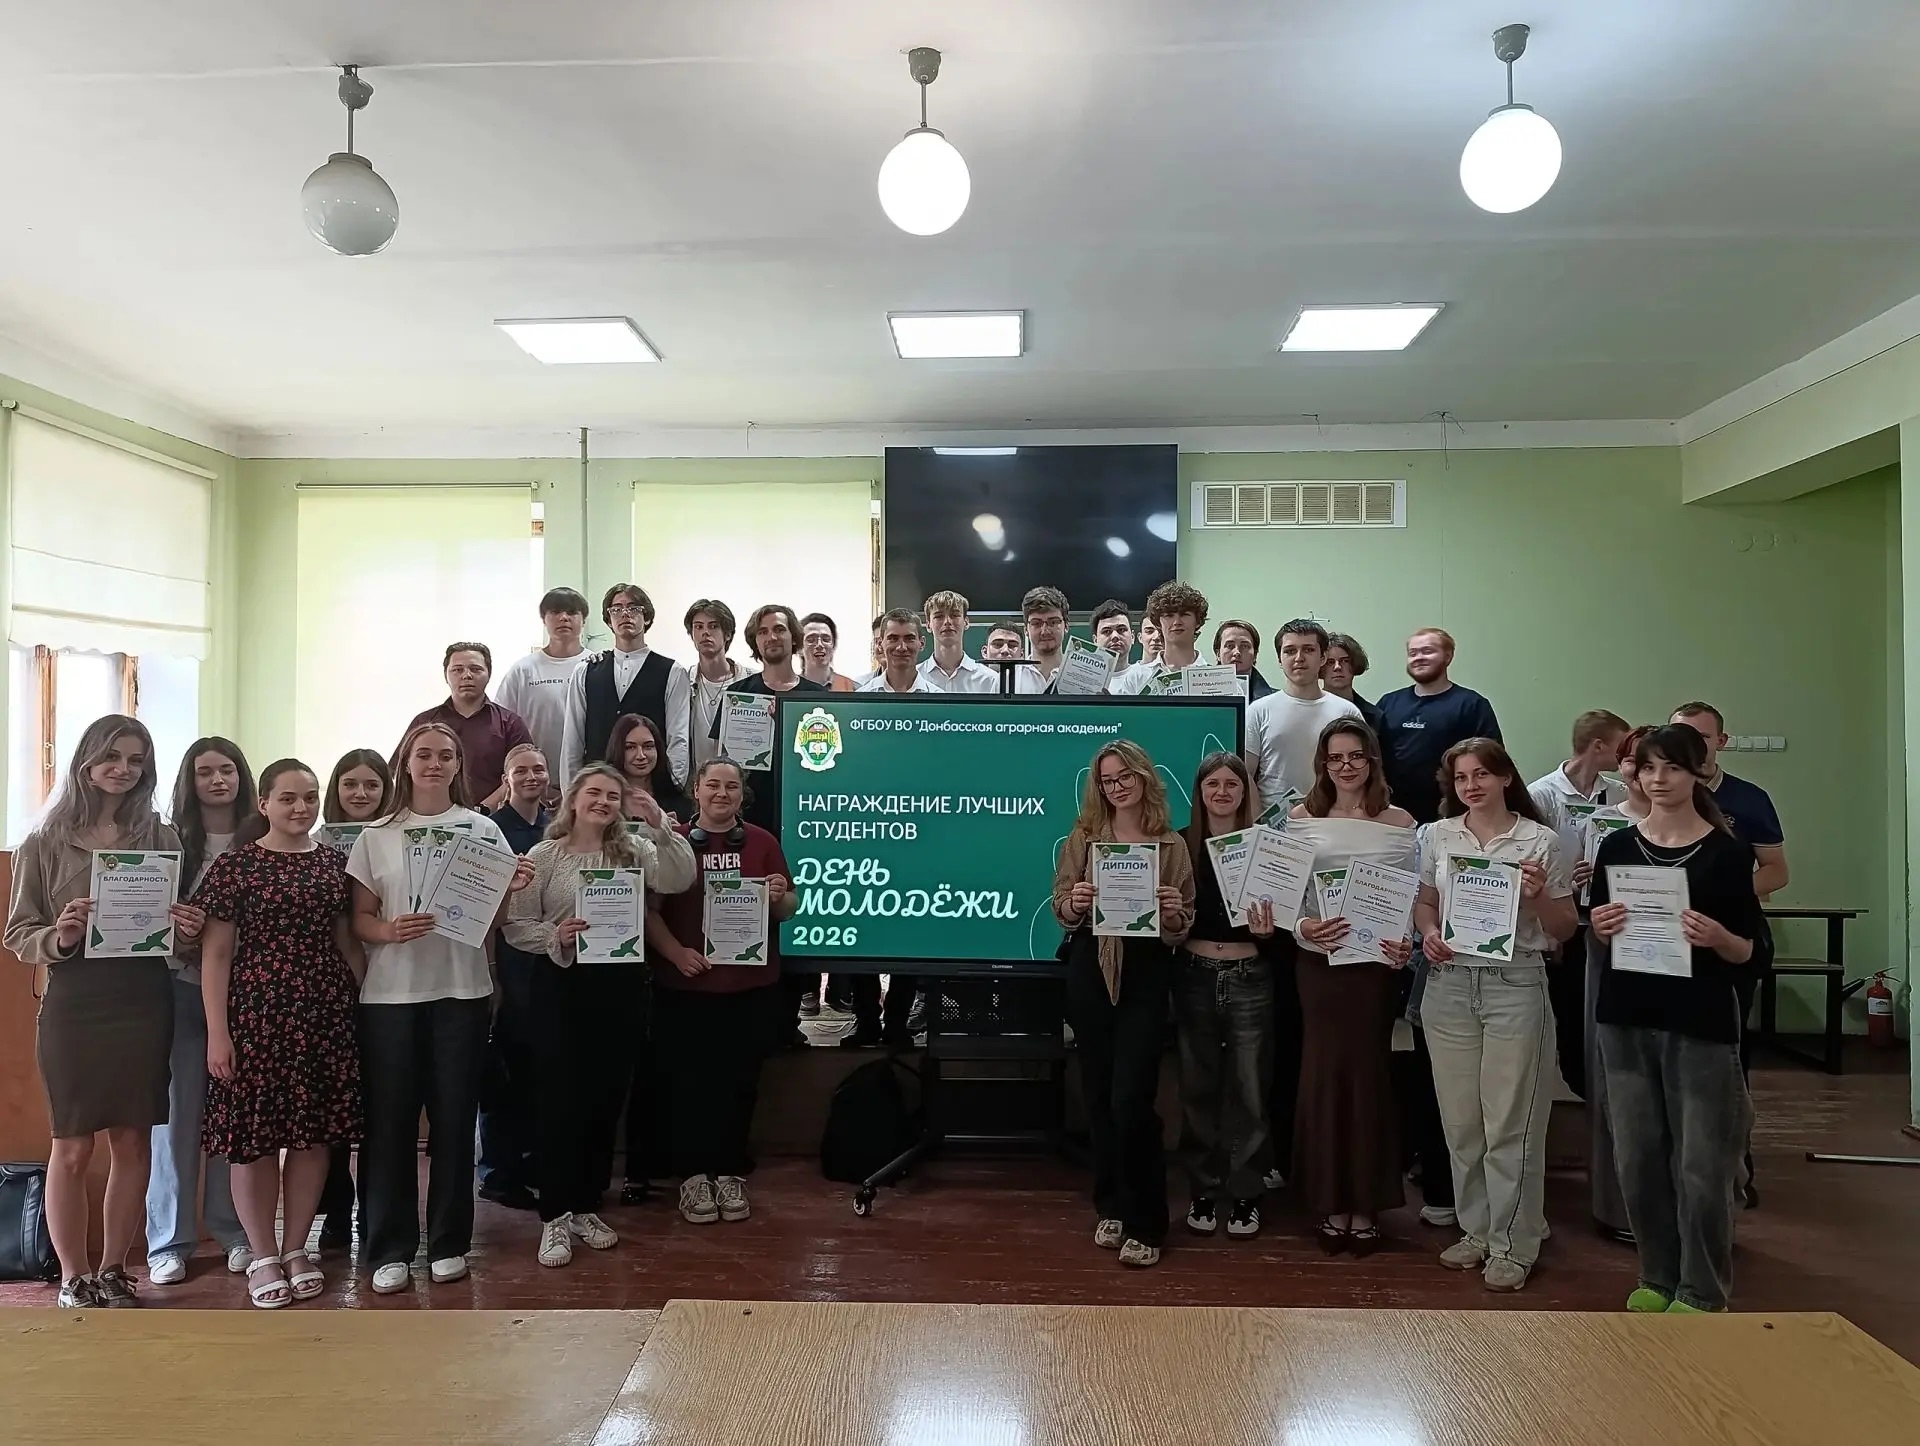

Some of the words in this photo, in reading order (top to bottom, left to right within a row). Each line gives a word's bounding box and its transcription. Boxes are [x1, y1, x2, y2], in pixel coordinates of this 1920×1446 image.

[1070, 652, 1106, 670] ДИПЛОМ
[528, 678, 564, 687] NUMBER
[1166, 685, 1184, 696] ДИП
[730, 708, 768, 718] ДИПЛОМ
[849, 719, 893, 731] ФГБОУ
[895, 719, 913, 731] ВО
[915, 719, 993, 734] "Донбасская
[995, 722, 1055, 735] аграрная
[1057, 722, 1122, 736] академия"
[1402, 721, 1425, 729] adidas
[798, 794, 952, 816] НАГРАЖДЕНИЕ
[956, 796, 1045, 815] ЛУЧШИХ
[797, 820, 918, 841] СТУДЕНТОВ
[702, 852, 741, 870] NEVER
[1101, 861, 1148, 871] ДИПЛОМ
[792, 857, 891, 887] ДЕНЬ
[1355, 879, 1409, 899] БЛАГОДАРНОСТЬ
[1456, 875, 1509, 889] ДИПЛОМ
[585, 887, 633, 897] ДИПЛОМ
[714, 896, 758, 905] ДИПЛОМ
[795, 883, 1019, 919] МОЛОДЁЖИ
[792, 926, 858, 946] 2026
